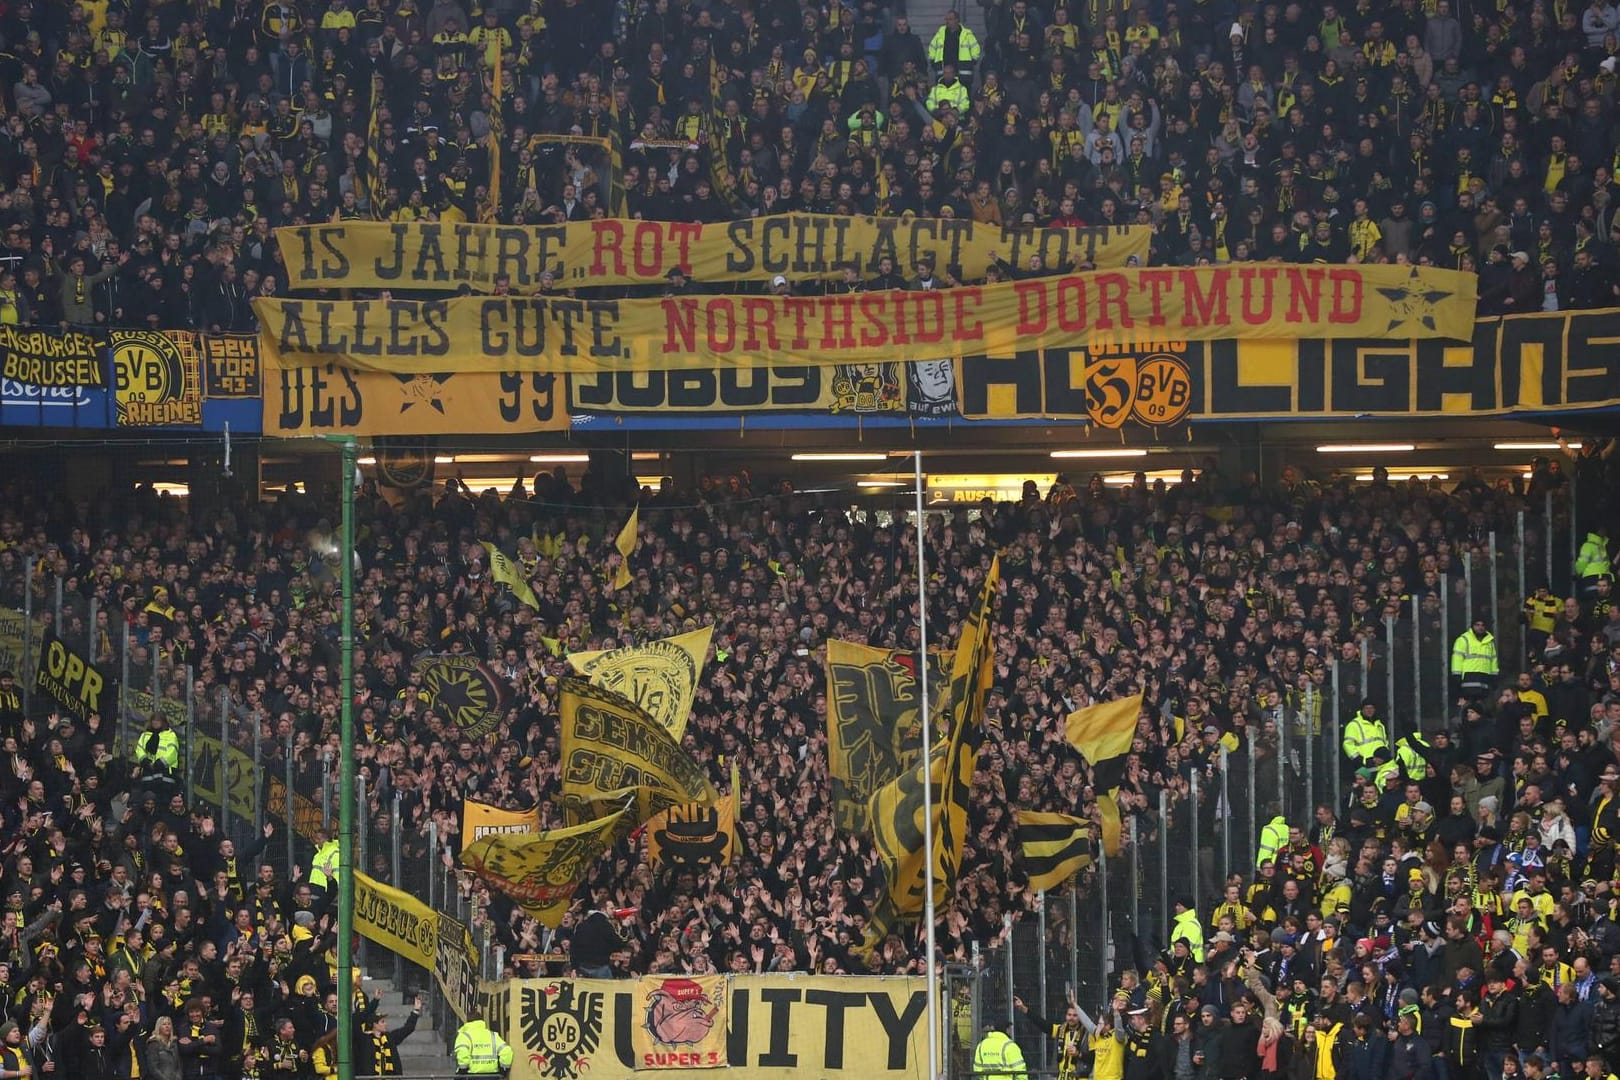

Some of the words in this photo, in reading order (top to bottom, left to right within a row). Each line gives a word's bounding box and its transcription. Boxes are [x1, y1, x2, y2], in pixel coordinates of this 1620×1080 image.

[375, 223, 566, 285] JAHRE
[726, 215, 973, 281] SCHLÄGT
[279, 301, 450, 356] ALLES
[661, 286, 984, 353] NORTHSIDE
[1014, 268, 1364, 336] DORTMUND
[4, 353, 102, 386] BORUSSEN
[114, 350, 163, 391] BVB
[211, 358, 254, 376] TOR
[129, 392, 146, 402] 09
[1137, 364, 1188, 407] BVB
[126, 401, 200, 424] RHEINE!
[1148, 404, 1166, 416] 09
[48, 639, 103, 712] OPR
[357, 886, 419, 947] LÜBECK
[548, 1017, 577, 1044] BVB
[555, 1042, 567, 1051] 09
[644, 1052, 702, 1067] SUPER
[707, 1051, 719, 1065] 3
